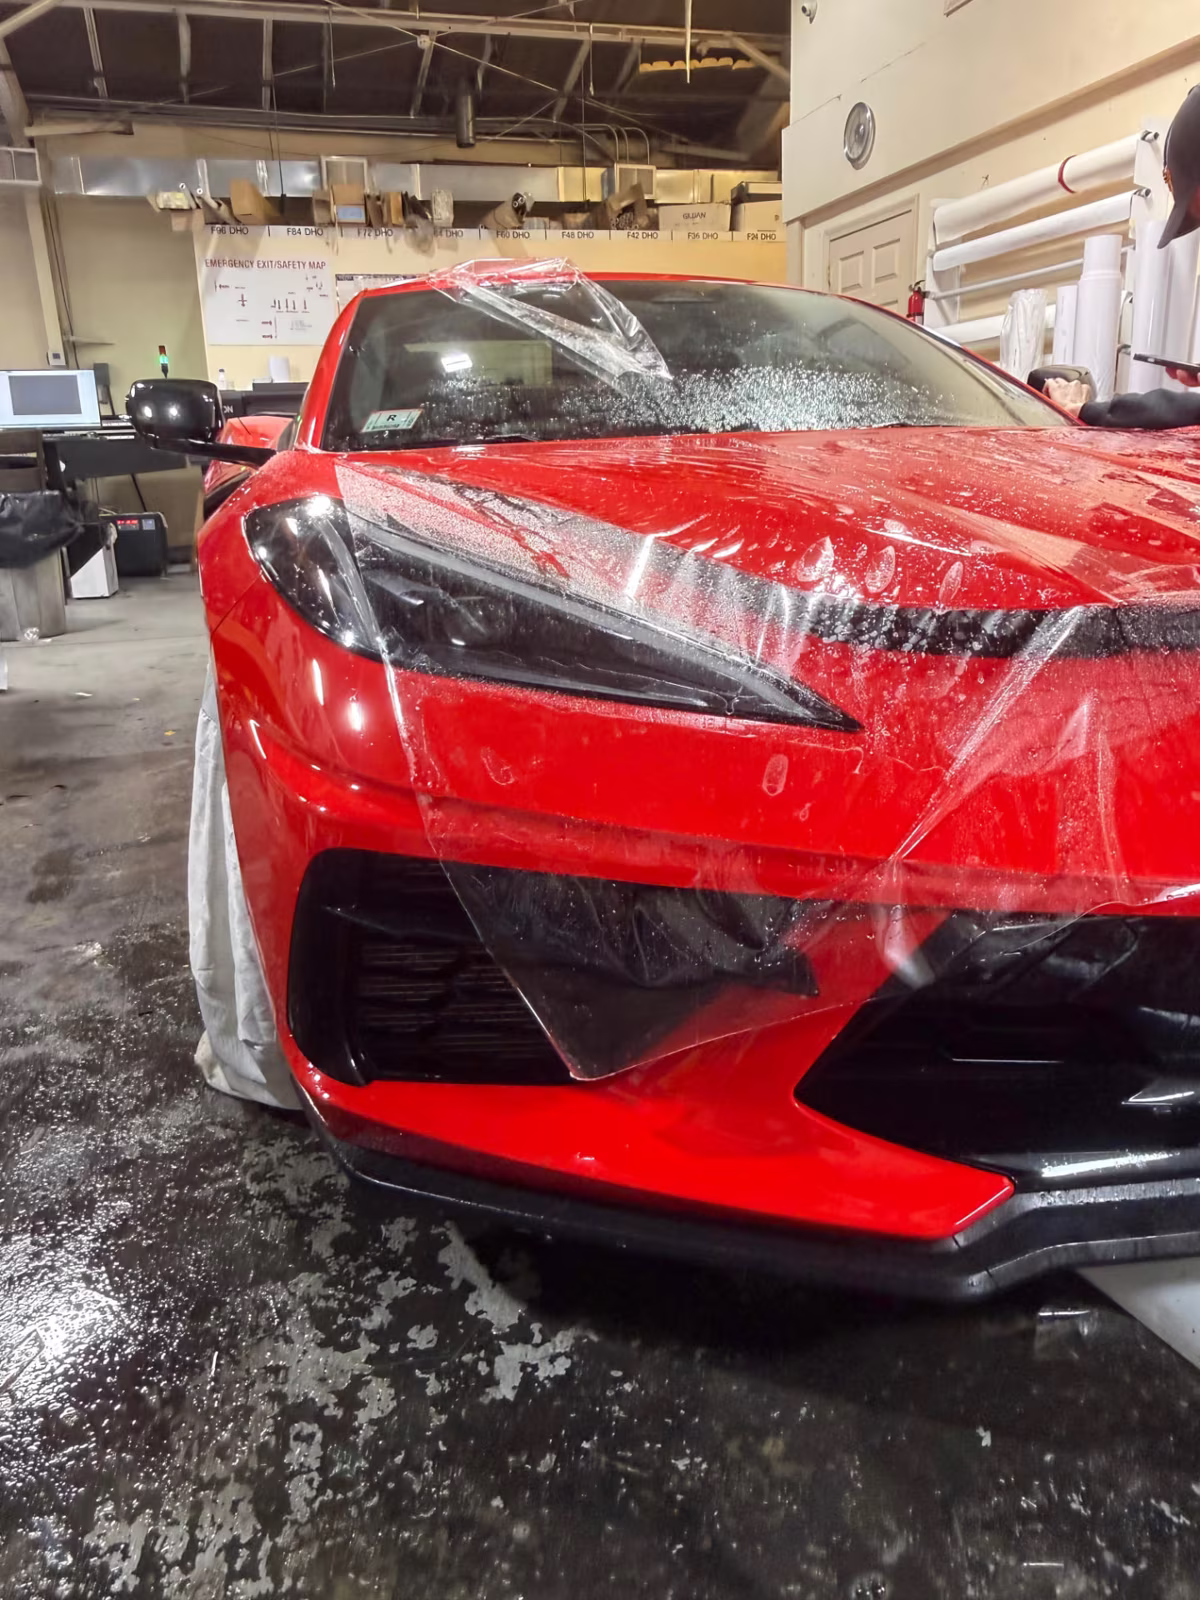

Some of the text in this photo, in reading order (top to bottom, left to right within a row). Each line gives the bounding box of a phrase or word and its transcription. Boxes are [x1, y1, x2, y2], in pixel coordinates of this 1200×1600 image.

[229, 227, 249, 235] DHO
[286, 228, 324, 236] F84 DHO
[375, 229, 394, 237] DHO
[445, 230, 464, 238] DHO
[496, 231, 530, 239] F60 DHO
[561, 231, 594, 239] F48 DHO
[627, 231, 640, 239] F42
[687, 232, 719, 240] F36 DHO
[746, 232, 777, 240] F24 DHO
[204, 258, 326, 270] EMERGENCY EXIT/SAFETY MAP
[386, 414, 397, 422] R
